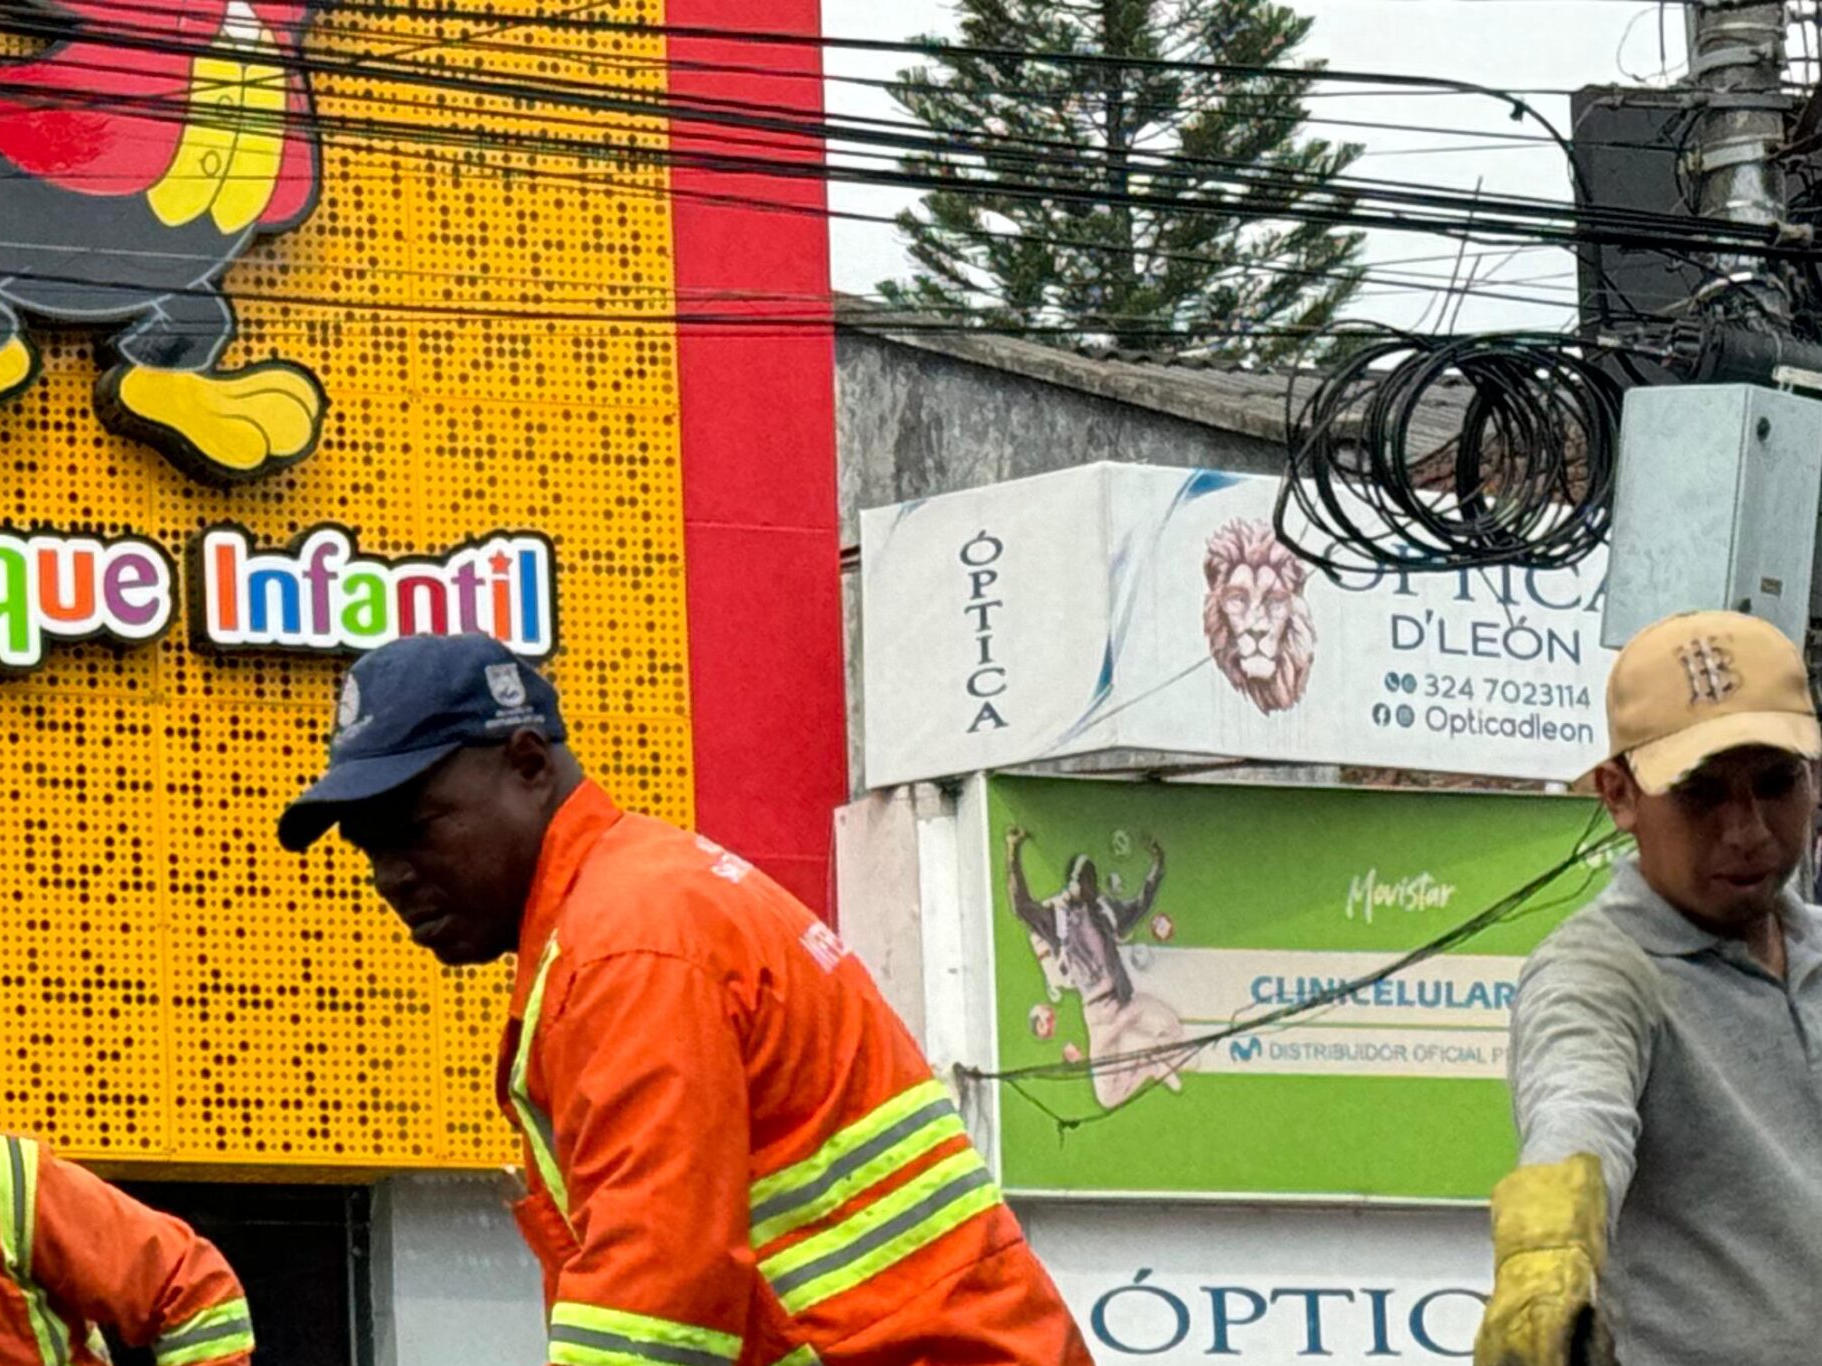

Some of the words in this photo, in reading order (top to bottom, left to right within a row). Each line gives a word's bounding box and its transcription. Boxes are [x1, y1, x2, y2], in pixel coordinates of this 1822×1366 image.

[210, 537, 541, 647] Infantil
[959, 529, 1009, 734] ÓPTICA
[1390, 608, 1581, 665] D'LEÓN
[1425, 673, 1474, 700] 324
[1482, 677, 1591, 708] 7023114
[1424, 705, 1594, 744] Opticadleon
[1345, 867, 1457, 924] Movistar
[1269, 1042, 1409, 1062] DISTRIBUIDOR
[1412, 1043, 1486, 1064] OFICIAL
